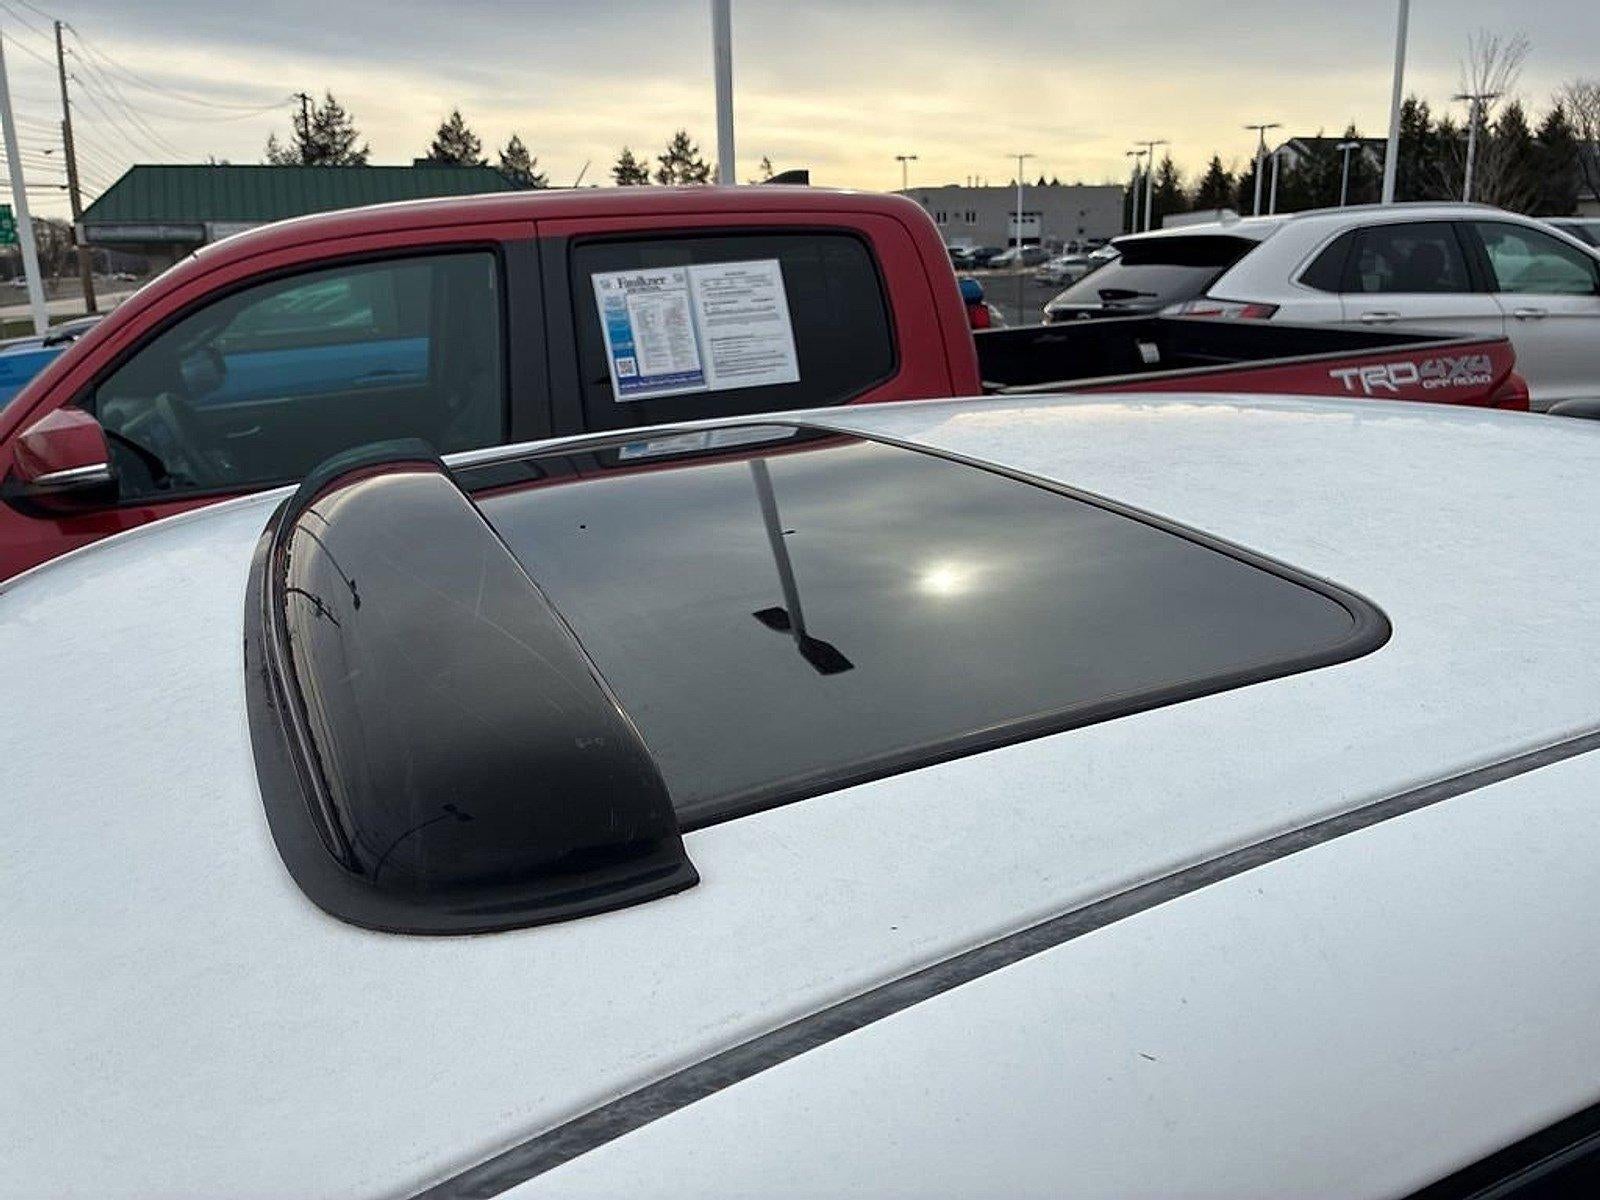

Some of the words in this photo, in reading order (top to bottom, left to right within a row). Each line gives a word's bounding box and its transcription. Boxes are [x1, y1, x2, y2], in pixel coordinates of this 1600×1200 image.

[1328, 361, 1417, 395] TRD
[1421, 377, 1450, 389] OFF
[1452, 374, 1491, 387] ROAD
